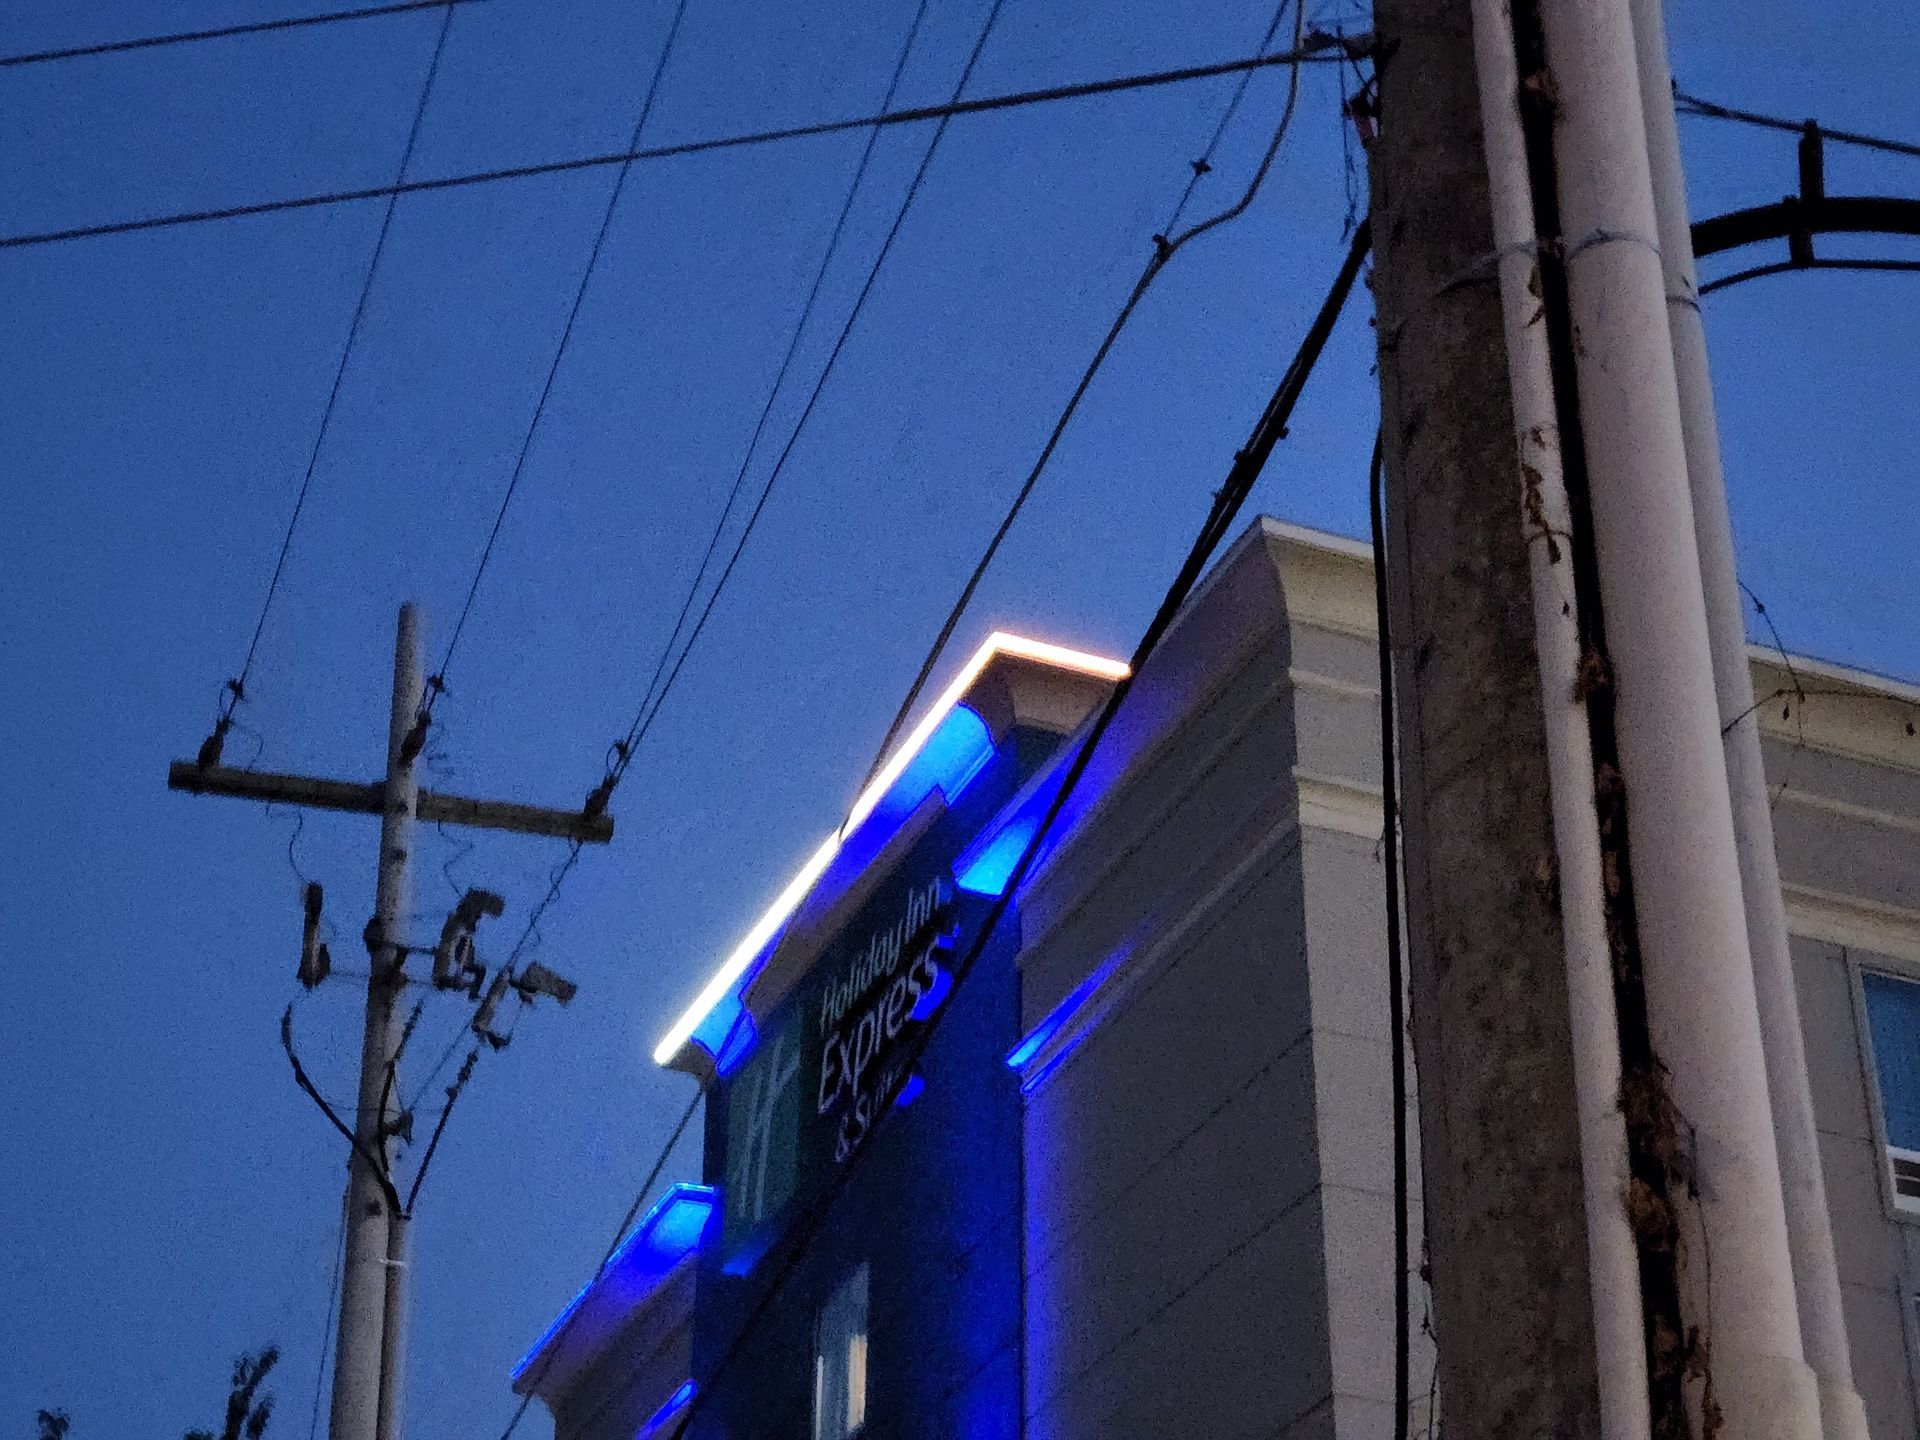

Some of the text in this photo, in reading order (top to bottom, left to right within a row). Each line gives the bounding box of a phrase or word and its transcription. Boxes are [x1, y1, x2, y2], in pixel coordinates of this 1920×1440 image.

[818, 935, 940, 1115] Express
[819, 875, 940, 1036] Holiday Inn
